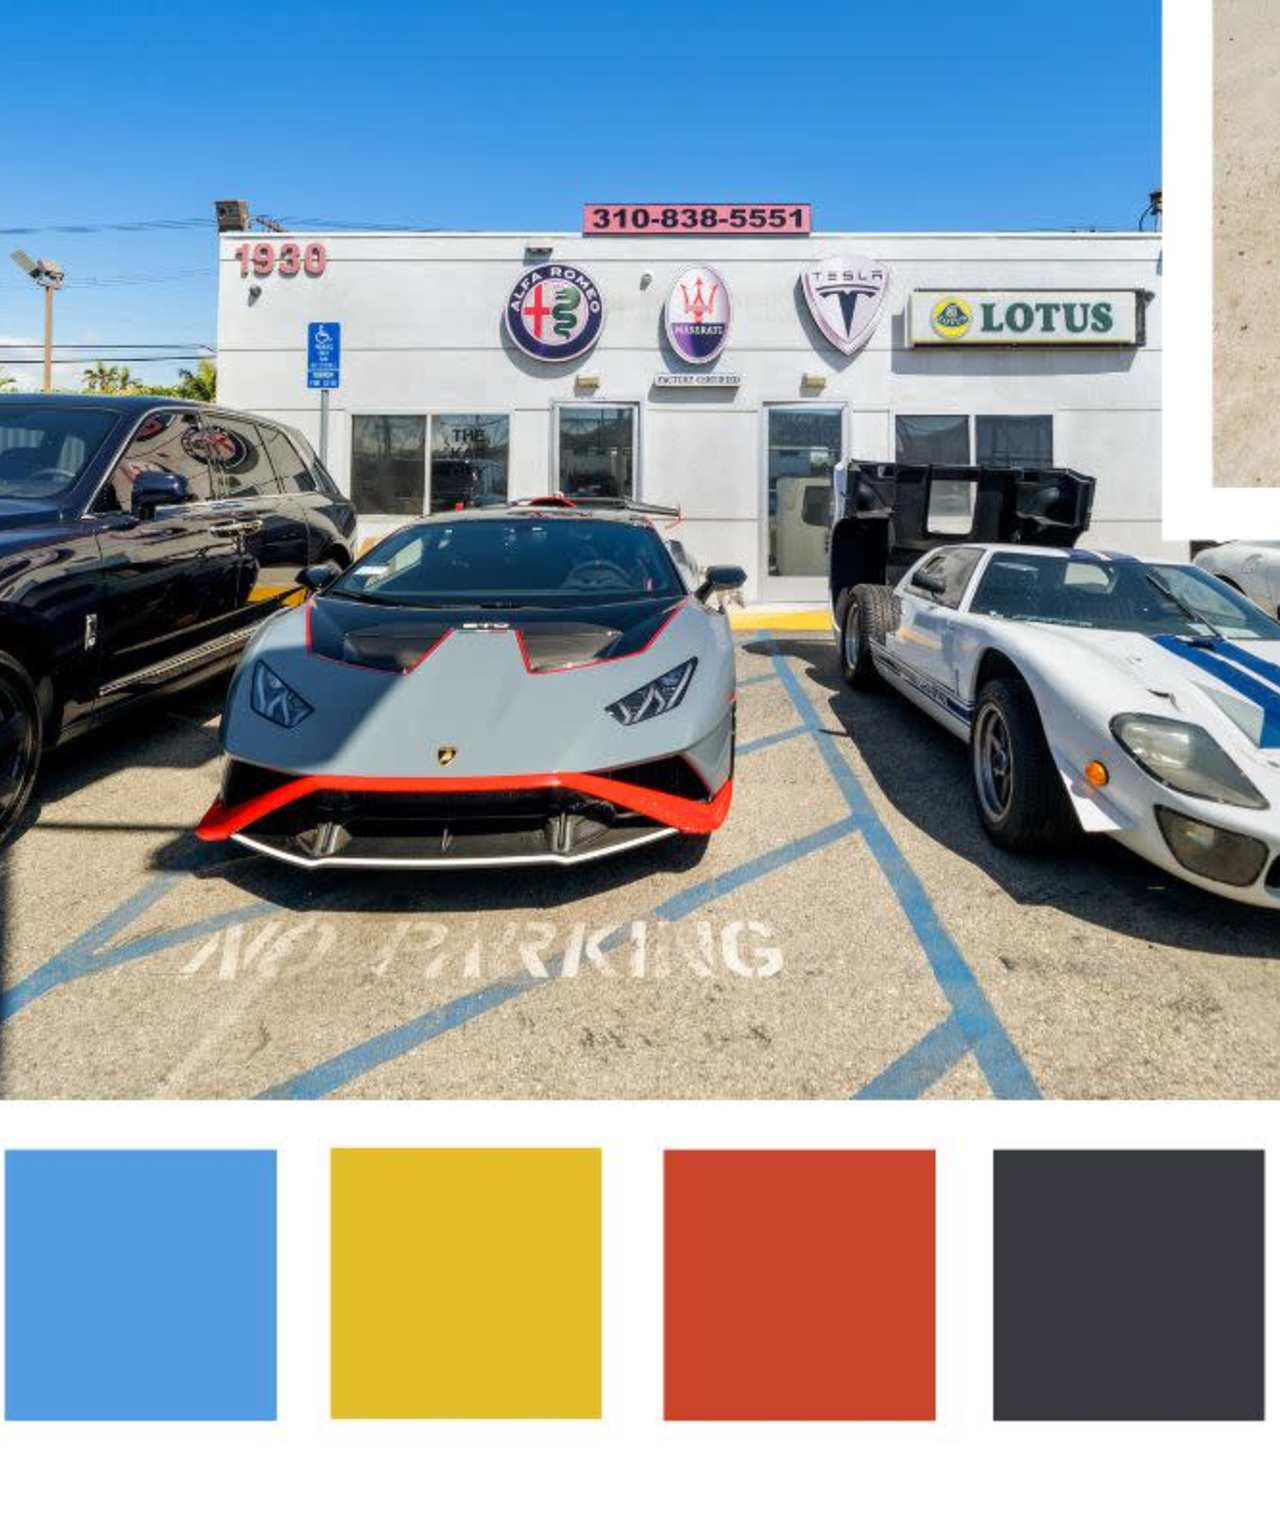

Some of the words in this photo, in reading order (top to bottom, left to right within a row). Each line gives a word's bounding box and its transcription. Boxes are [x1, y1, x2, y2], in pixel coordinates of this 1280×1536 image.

[593, 209, 804, 229] 310-838-5551
[237, 243, 327, 276] 1930
[510, 269, 543, 312] ALFA
[550, 267, 600, 314] ROMEO
[812, 271, 883, 280] TESLA
[981, 303, 1113, 333] LOTUS
[452, 428, 486, 442] THE
[181, 921, 337, 977] NO
